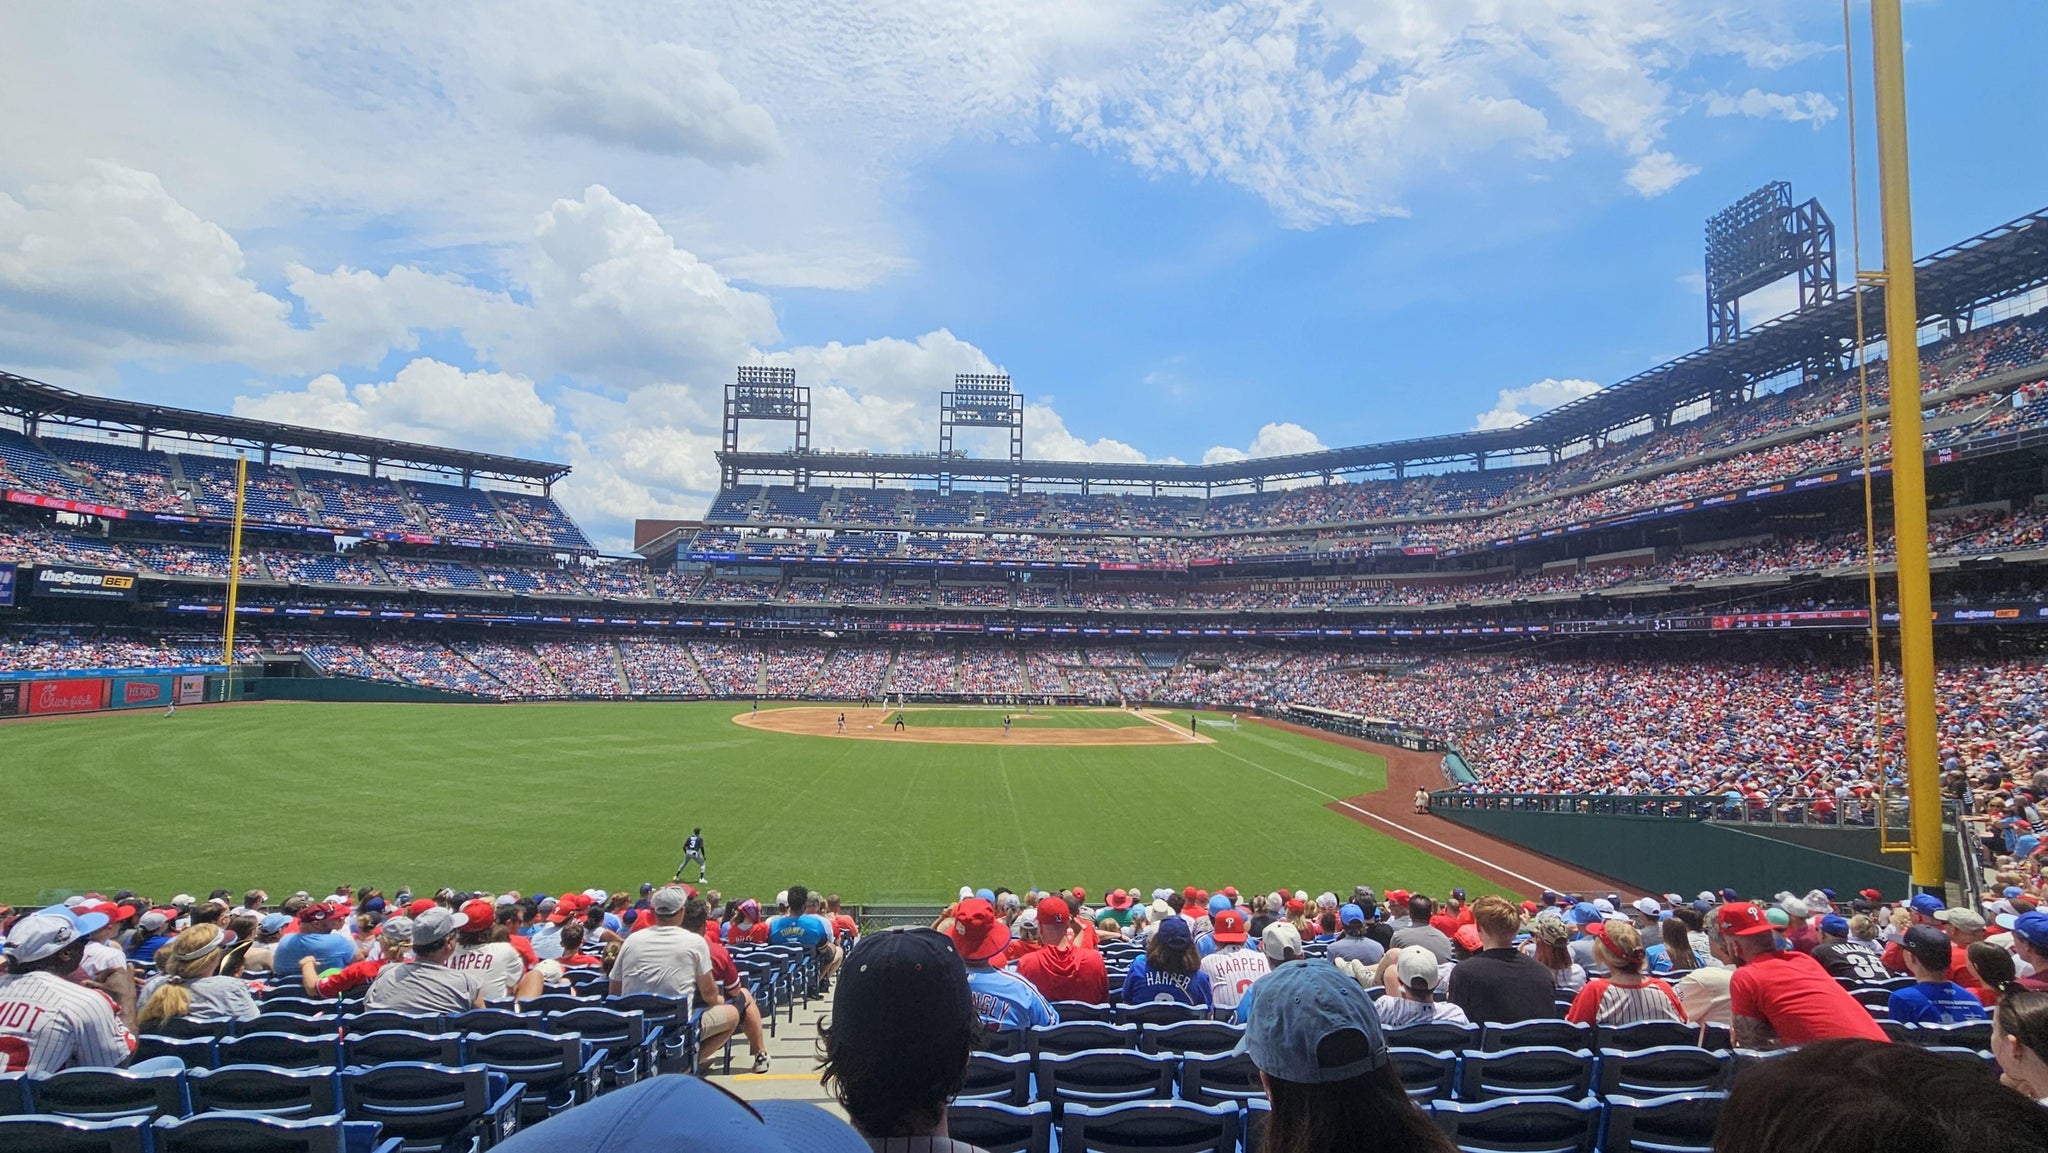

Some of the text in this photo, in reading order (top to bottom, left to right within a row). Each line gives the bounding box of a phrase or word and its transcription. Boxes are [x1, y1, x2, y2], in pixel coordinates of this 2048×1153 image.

[1938, 448, 1952, 456] MIA
[1940, 455, 1952, 463] PHI
[39, 570, 130, 587] theScore BET
[1251, 583, 1269, 591] HOME
[1284, 582, 1296, 590] THE
[1300, 580, 1351, 590] PHILADELPH
[1748, 906, 1759, 921] P
[1225, 917, 1234, 928] P
[781, 927, 805, 937] TURNER
[1216, 957, 1265, 977] HARPER
[1146, 971, 1191, 990] HARPER
